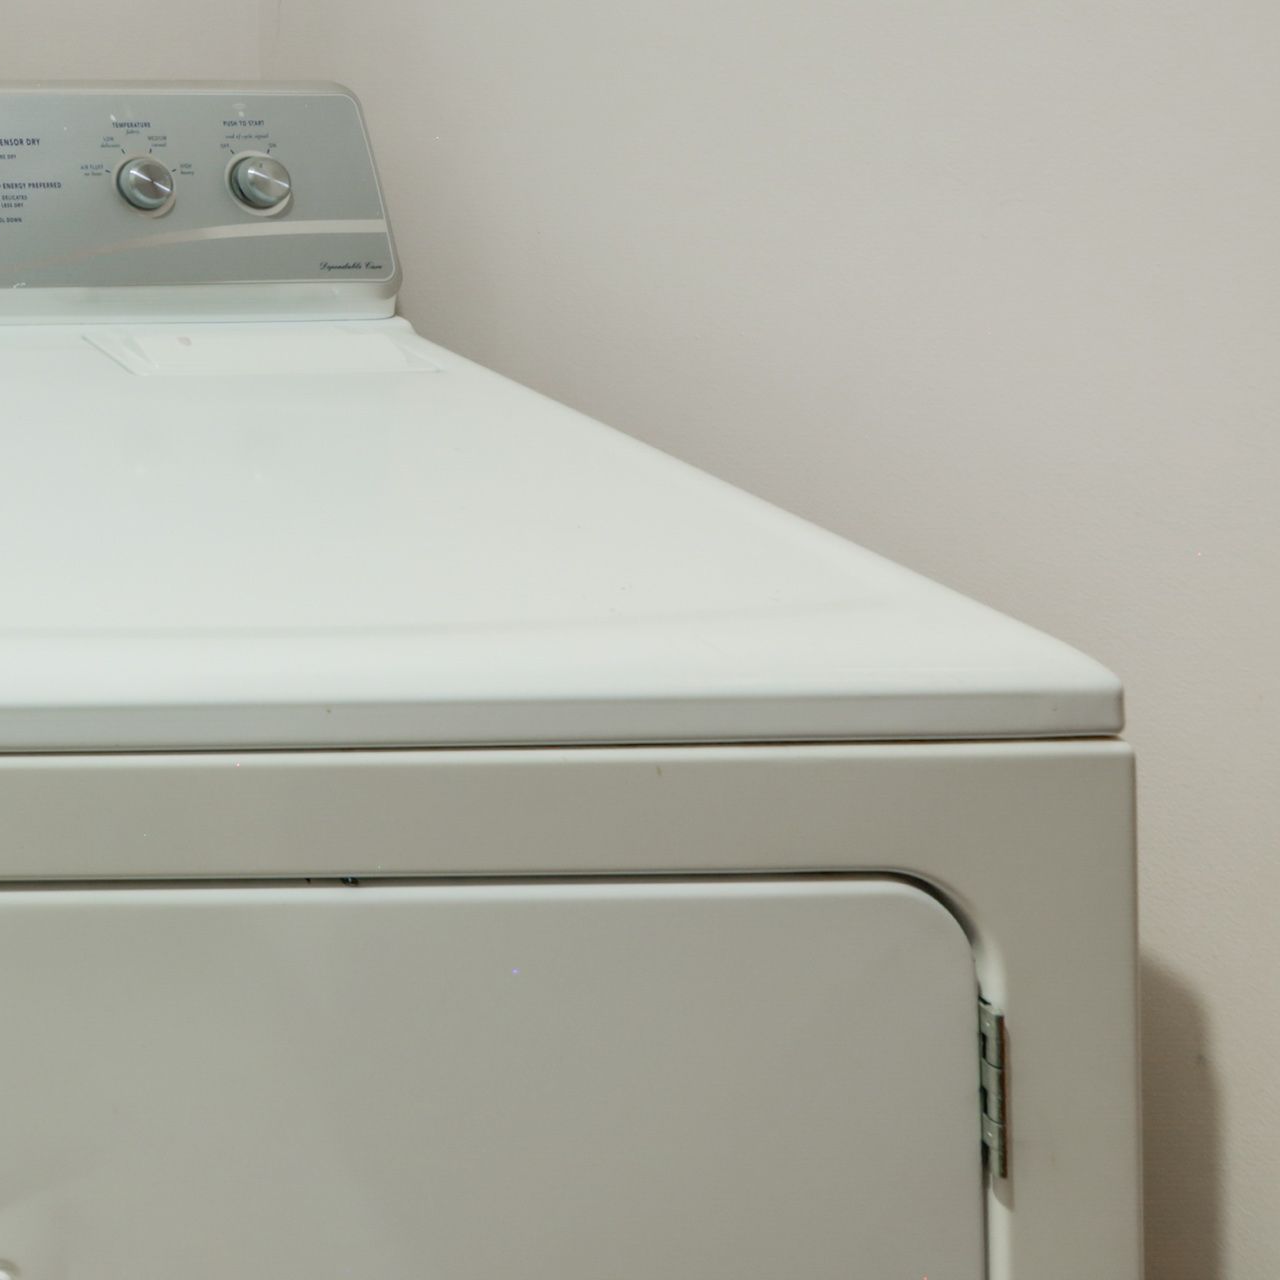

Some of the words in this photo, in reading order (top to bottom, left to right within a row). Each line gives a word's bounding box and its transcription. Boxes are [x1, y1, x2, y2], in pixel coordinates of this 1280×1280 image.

[25, 138, 40, 146] DRY
[2, 182, 27, 190] ENERGY
[320, 261, 362, 272] Dependable
[365, 261, 383, 270] Care
